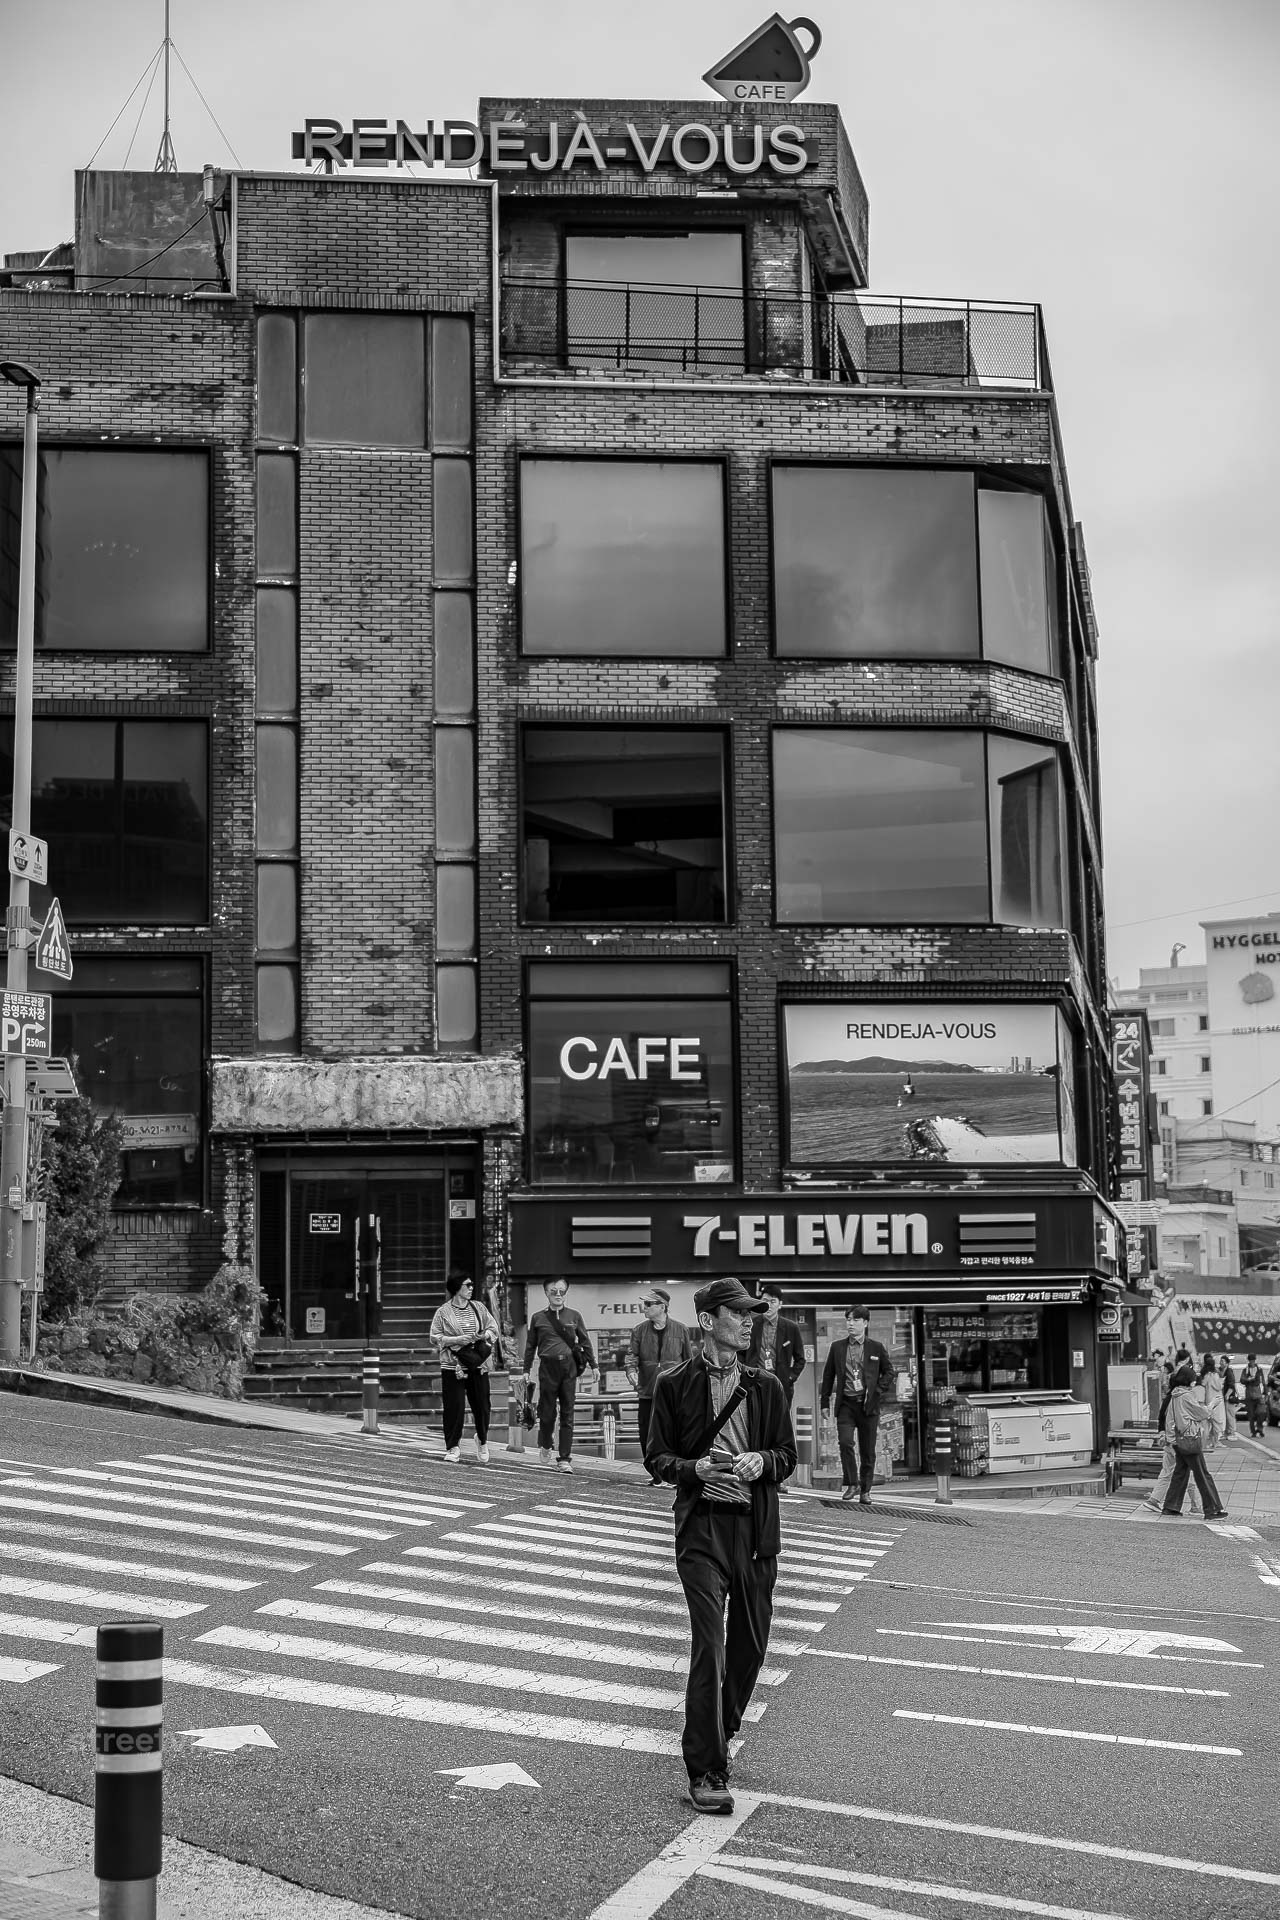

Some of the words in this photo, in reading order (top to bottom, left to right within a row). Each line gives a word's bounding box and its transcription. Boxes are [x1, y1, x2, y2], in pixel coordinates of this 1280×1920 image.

[733, 84, 786, 99] CAFE
[2, 1004, 46, 1020] 공영주차장
[2, 1018, 20, 1051] P
[846, 1023, 997, 1040] RENDEJA-VOUS
[1114, 1022, 1139, 1040] 24
[26, 1037, 46, 1049] 250m
[559, 1036, 702, 1081] CAFE
